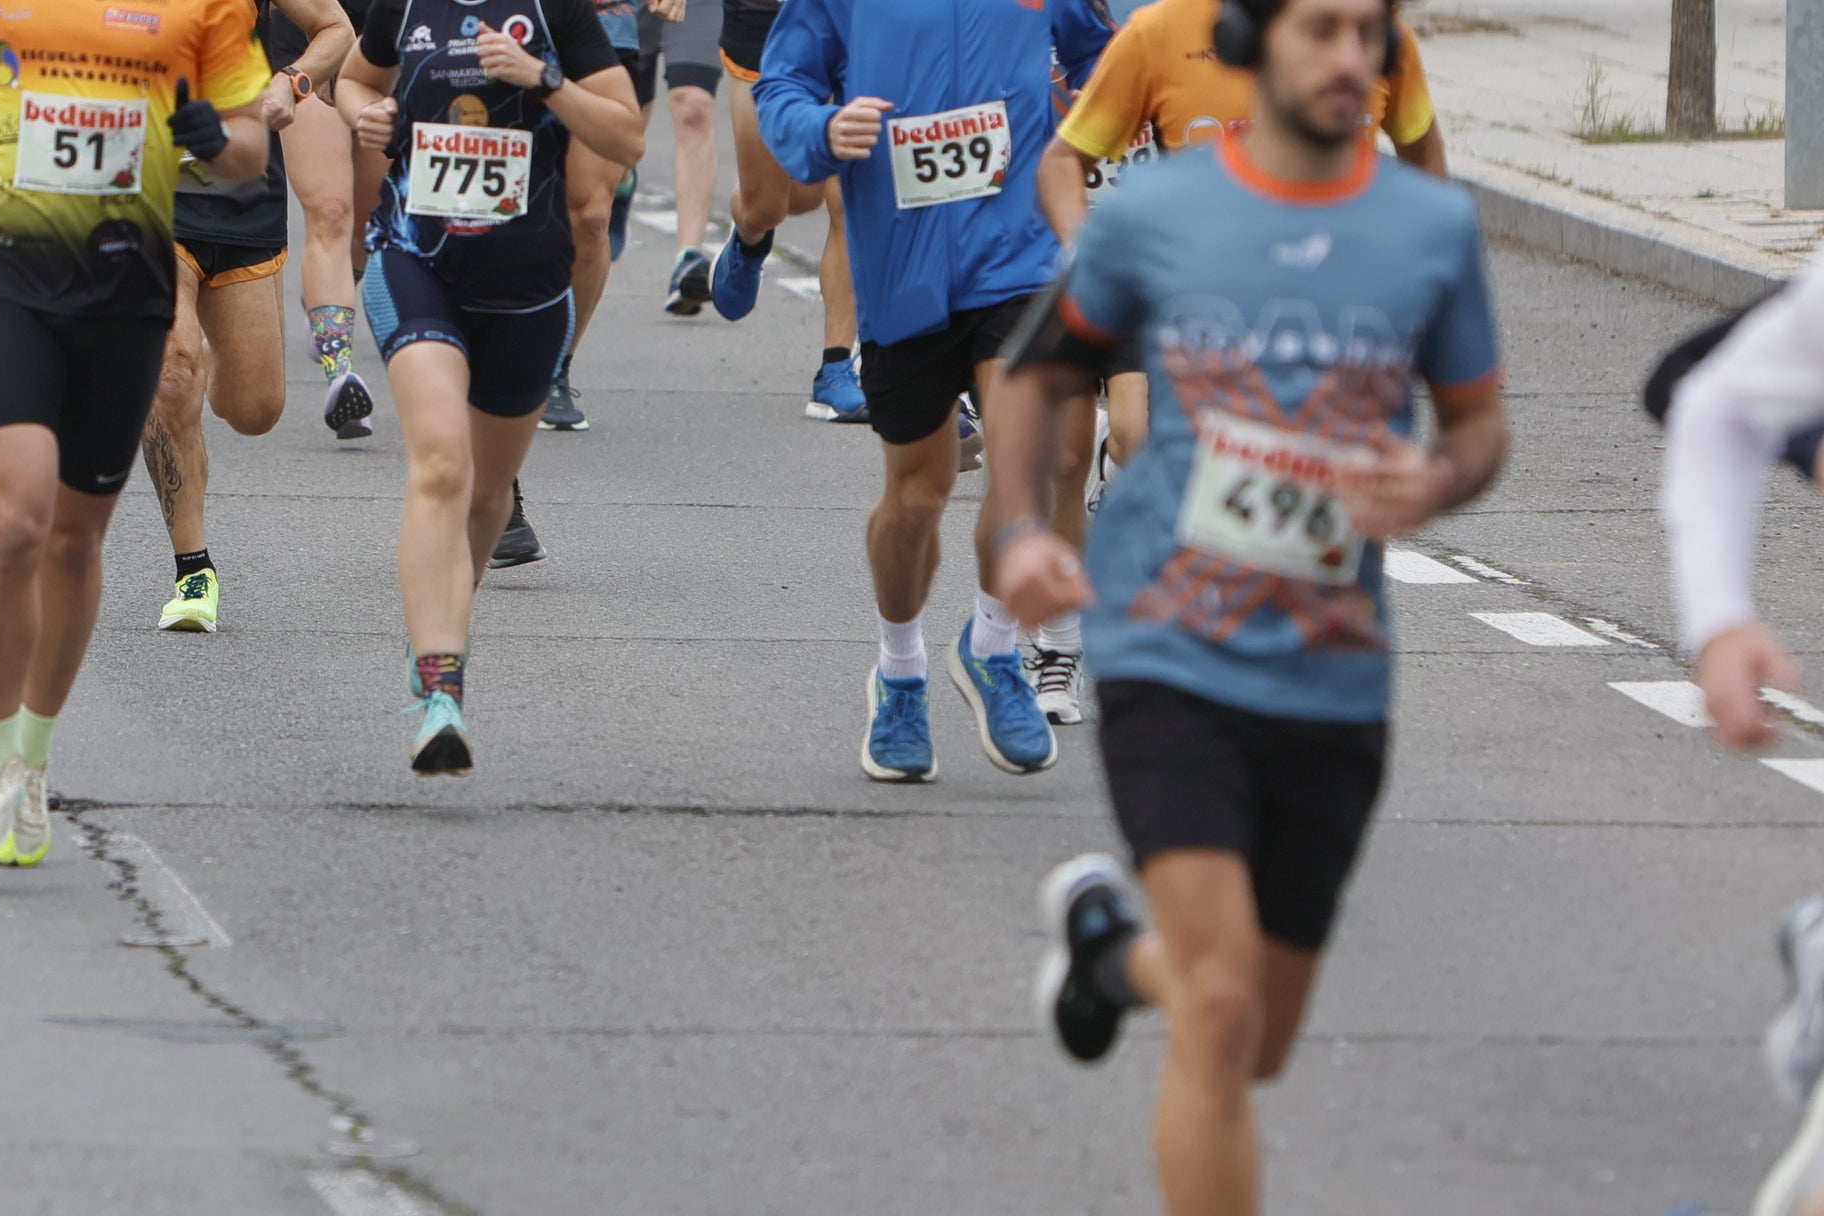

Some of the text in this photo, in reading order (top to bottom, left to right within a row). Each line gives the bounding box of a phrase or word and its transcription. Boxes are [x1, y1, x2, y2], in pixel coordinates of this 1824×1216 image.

[20, 48, 89, 64] ESCUELA
[25, 100, 143, 129] bedunia
[892, 112, 1005, 147] bedunia
[53, 129, 105, 171] 51
[417, 129, 527, 158] bedunia
[911, 136, 993, 183] 539
[429, 156, 507, 197] 775
[1222, 477, 1336, 542] 496
